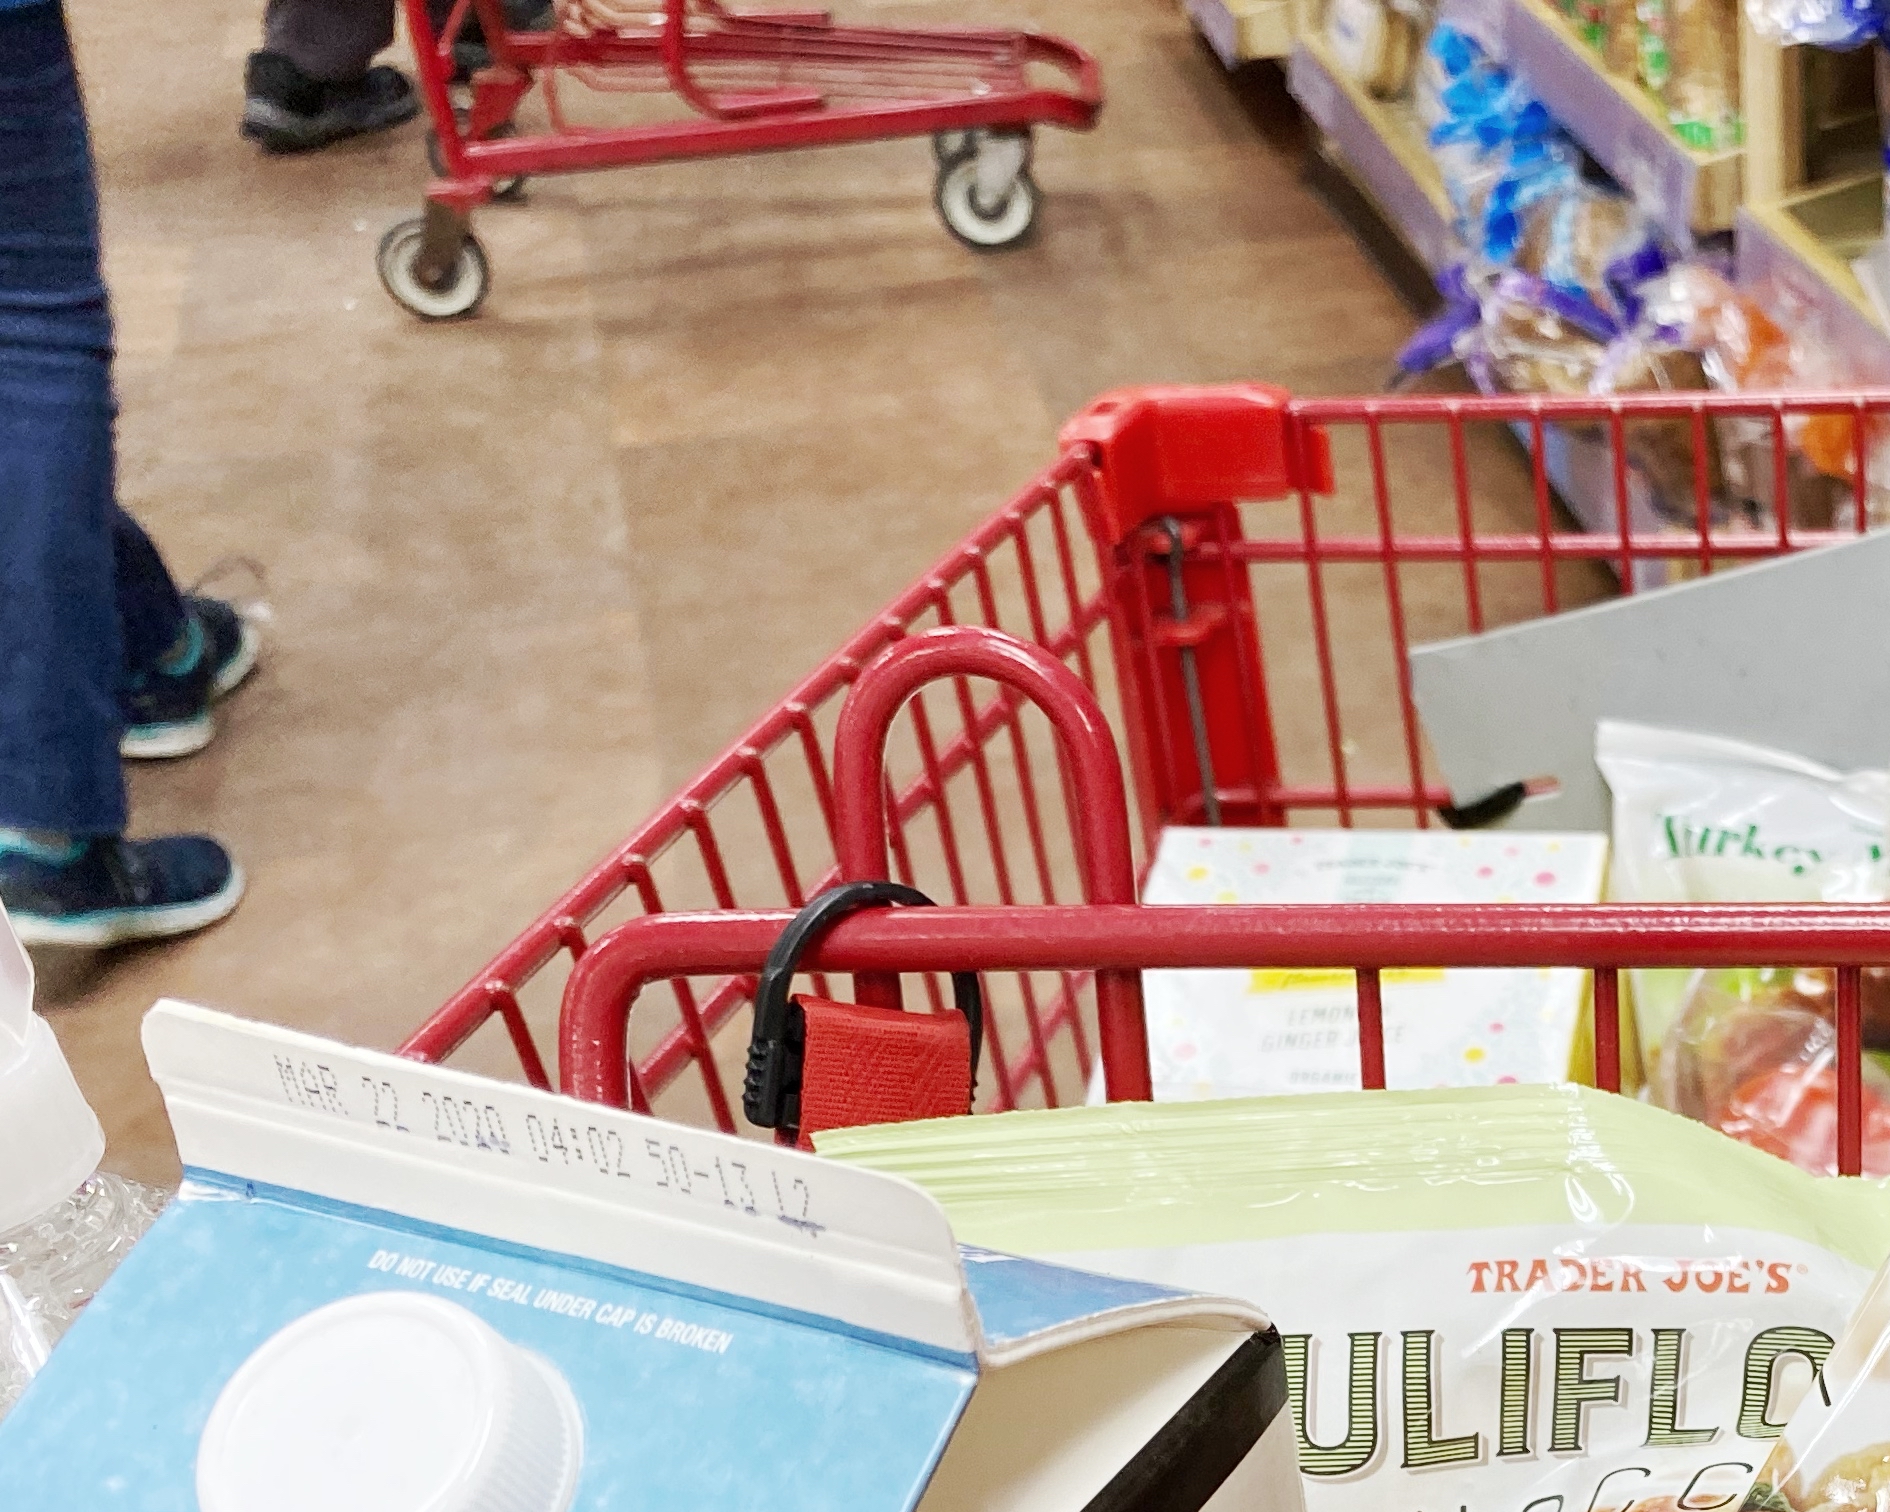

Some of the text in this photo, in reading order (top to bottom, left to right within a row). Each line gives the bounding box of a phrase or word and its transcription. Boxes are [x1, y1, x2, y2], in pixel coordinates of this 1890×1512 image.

[273, 1054, 348, 1116] MAR
[362, 1077, 409, 1132] 22
[422, 1092, 510, 1155] 2020
[525, 1114, 631, 1178] 04:02
[367, 1250, 733, 1355] DO NOT USE IF SEAL UNDER CAP IS BROKEN
[1467, 1259, 1647, 1295] TRADER
